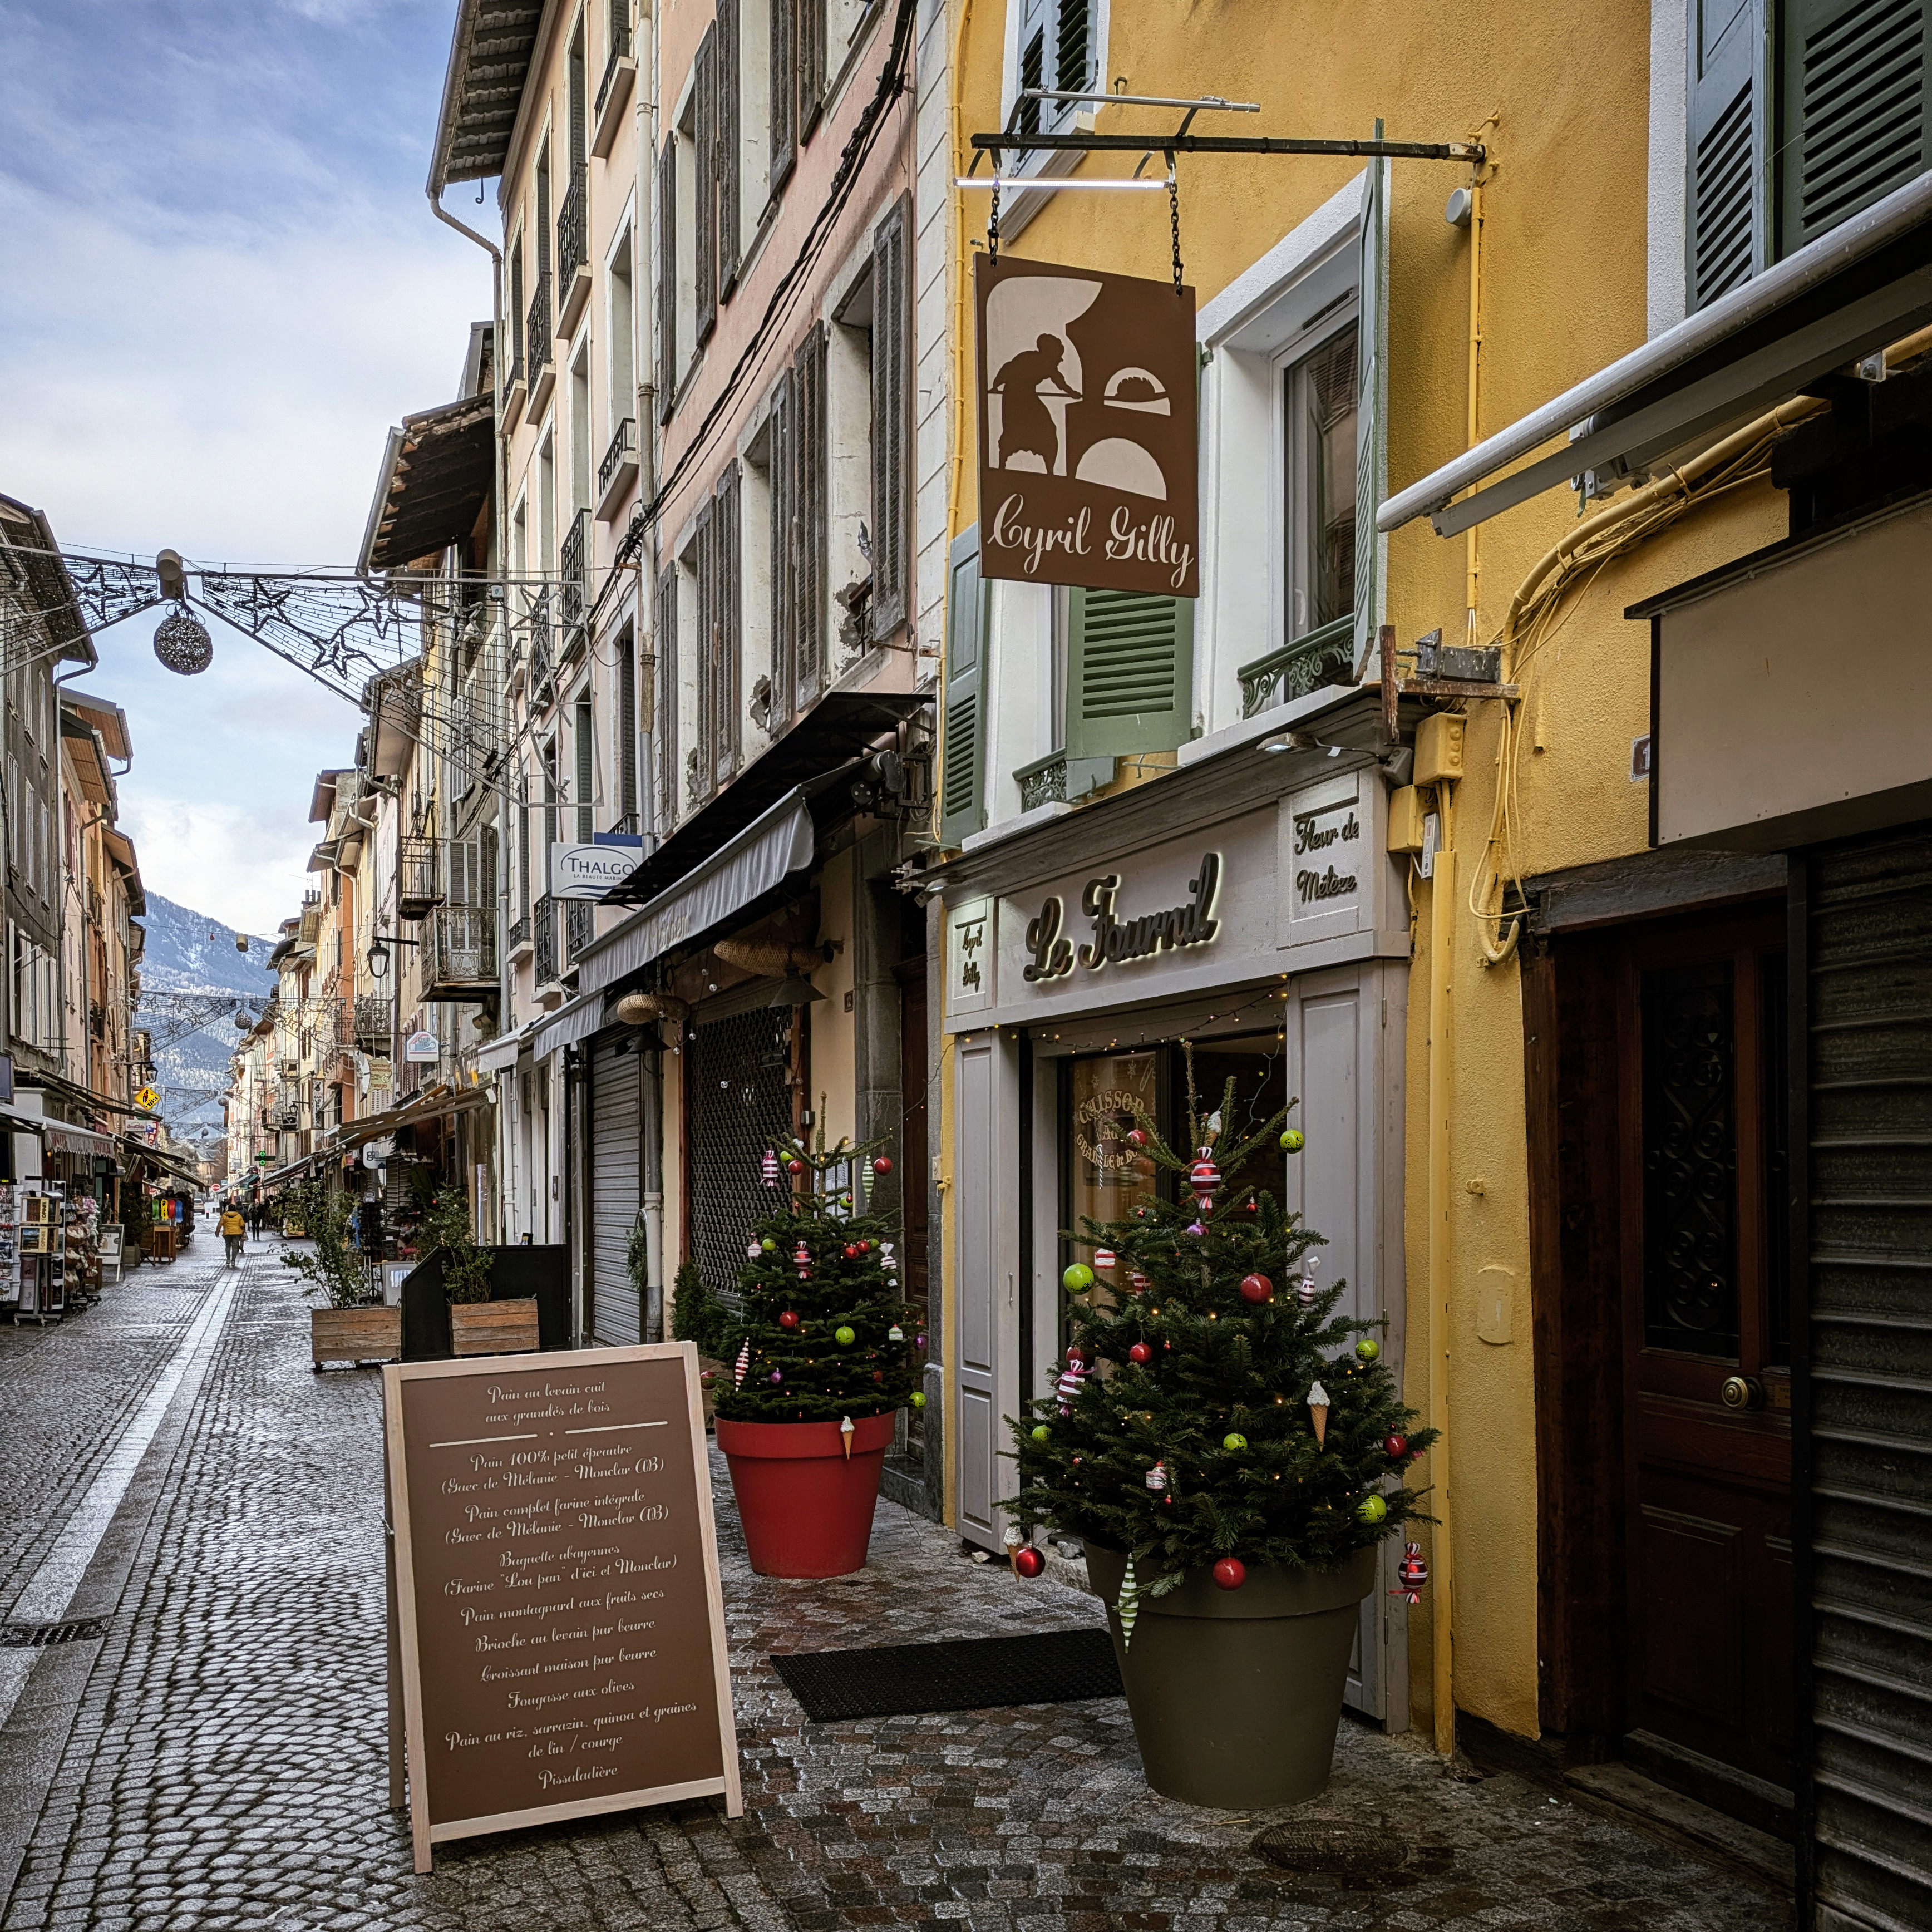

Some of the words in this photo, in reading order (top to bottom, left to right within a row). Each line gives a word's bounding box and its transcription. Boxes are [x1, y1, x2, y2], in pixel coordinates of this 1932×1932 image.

[987, 493, 1091, 574] Cyril
[1105, 506, 1195, 588] Gilly
[1294, 816, 1339, 856] Fleur
[1341, 811, 1359, 842] de
[567, 857, 635, 875] THALGO
[1297, 864, 1358, 903] Mélèze
[1023, 897, 1074, 982] Le
[1078, 852, 1221, 969] Fournil
[962, 924, 983, 960] Cyril
[962, 961, 981, 993] Gilly
[1077, 1134, 1115, 1170] GRANLE
[1116, 1153, 1124, 1168] de
[487, 1386, 520, 1403] Pain
[545, 1383, 580, 1397] levain
[584, 1381, 605, 1393] cuit
[485, 1414, 509, 1422] aux
[513, 1403, 564, 1426] granulés
[569, 1402, 583, 1415] de
[588, 1399, 610, 1413] bois
[470, 1453, 502, 1471] Pain
[508, 1450, 550, 1466] 100%
[554, 1448, 578, 1467] petit
[583, 1444, 632, 1463] épeautre
[442, 1477, 479, 1494] (Gaec
[483, 1477, 498, 1490] de
[502, 1471, 558, 1487] Mélanie
[574, 1462, 630, 1480] Monclar
[465, 1504, 499, 1522] Pain
[503, 1499, 551, 1519] complet
[554, 1497, 590, 1516] farine
[594, 1488, 645, 1510] intégrale
[445, 1527, 482, 1545] (Gaec
[487, 1526, 502, 1539] de
[506, 1520, 563, 1537] Mélanie
[578, 1510, 635, 1529] Monclar
[444, 1578, 495, 1596] (Farine
[600, 1564, 610, 1576] et
[615, 1554, 677, 1574] Monclar)
[499, 1551, 554, 1571] Baguette
[559, 1545, 620, 1564] ubayennes
[460, 1606, 494, 1626] Pain
[499, 1597, 574, 1620] montagnard
[579, 1598, 603, 1608] aux
[606, 1590, 638, 1610] fruits
[640, 1590, 665, 1600] secs
[475, 1632, 526, 1652] Brioche
[530, 1635, 546, 1644] au
[551, 1627, 589, 1642] levain
[592, 1625, 613, 1642] pur
[618, 1618, 656, 1633] beurre
[480, 1663, 540, 1682] Croissant
[544, 1658, 590, 1673] maison
[593, 1655, 614, 1671] pur
[619, 1647, 657, 1662] beurre
[507, 1690, 570, 1711] Fougasse
[573, 1688, 598, 1699] aux
[601, 1679, 634, 1694] olives
[445, 1731, 481, 1751] Pain
[485, 1733, 502, 1743] au
[593, 1712, 636, 1732] quinoa
[639, 1706, 651, 1719] et
[654, 1702, 697, 1723] graines
[528, 1744, 544, 1758] de
[548, 1740, 565, 1755] lin
[581, 1736, 624, 1752] courge
[538, 1766, 619, 1790] Pissaladière
